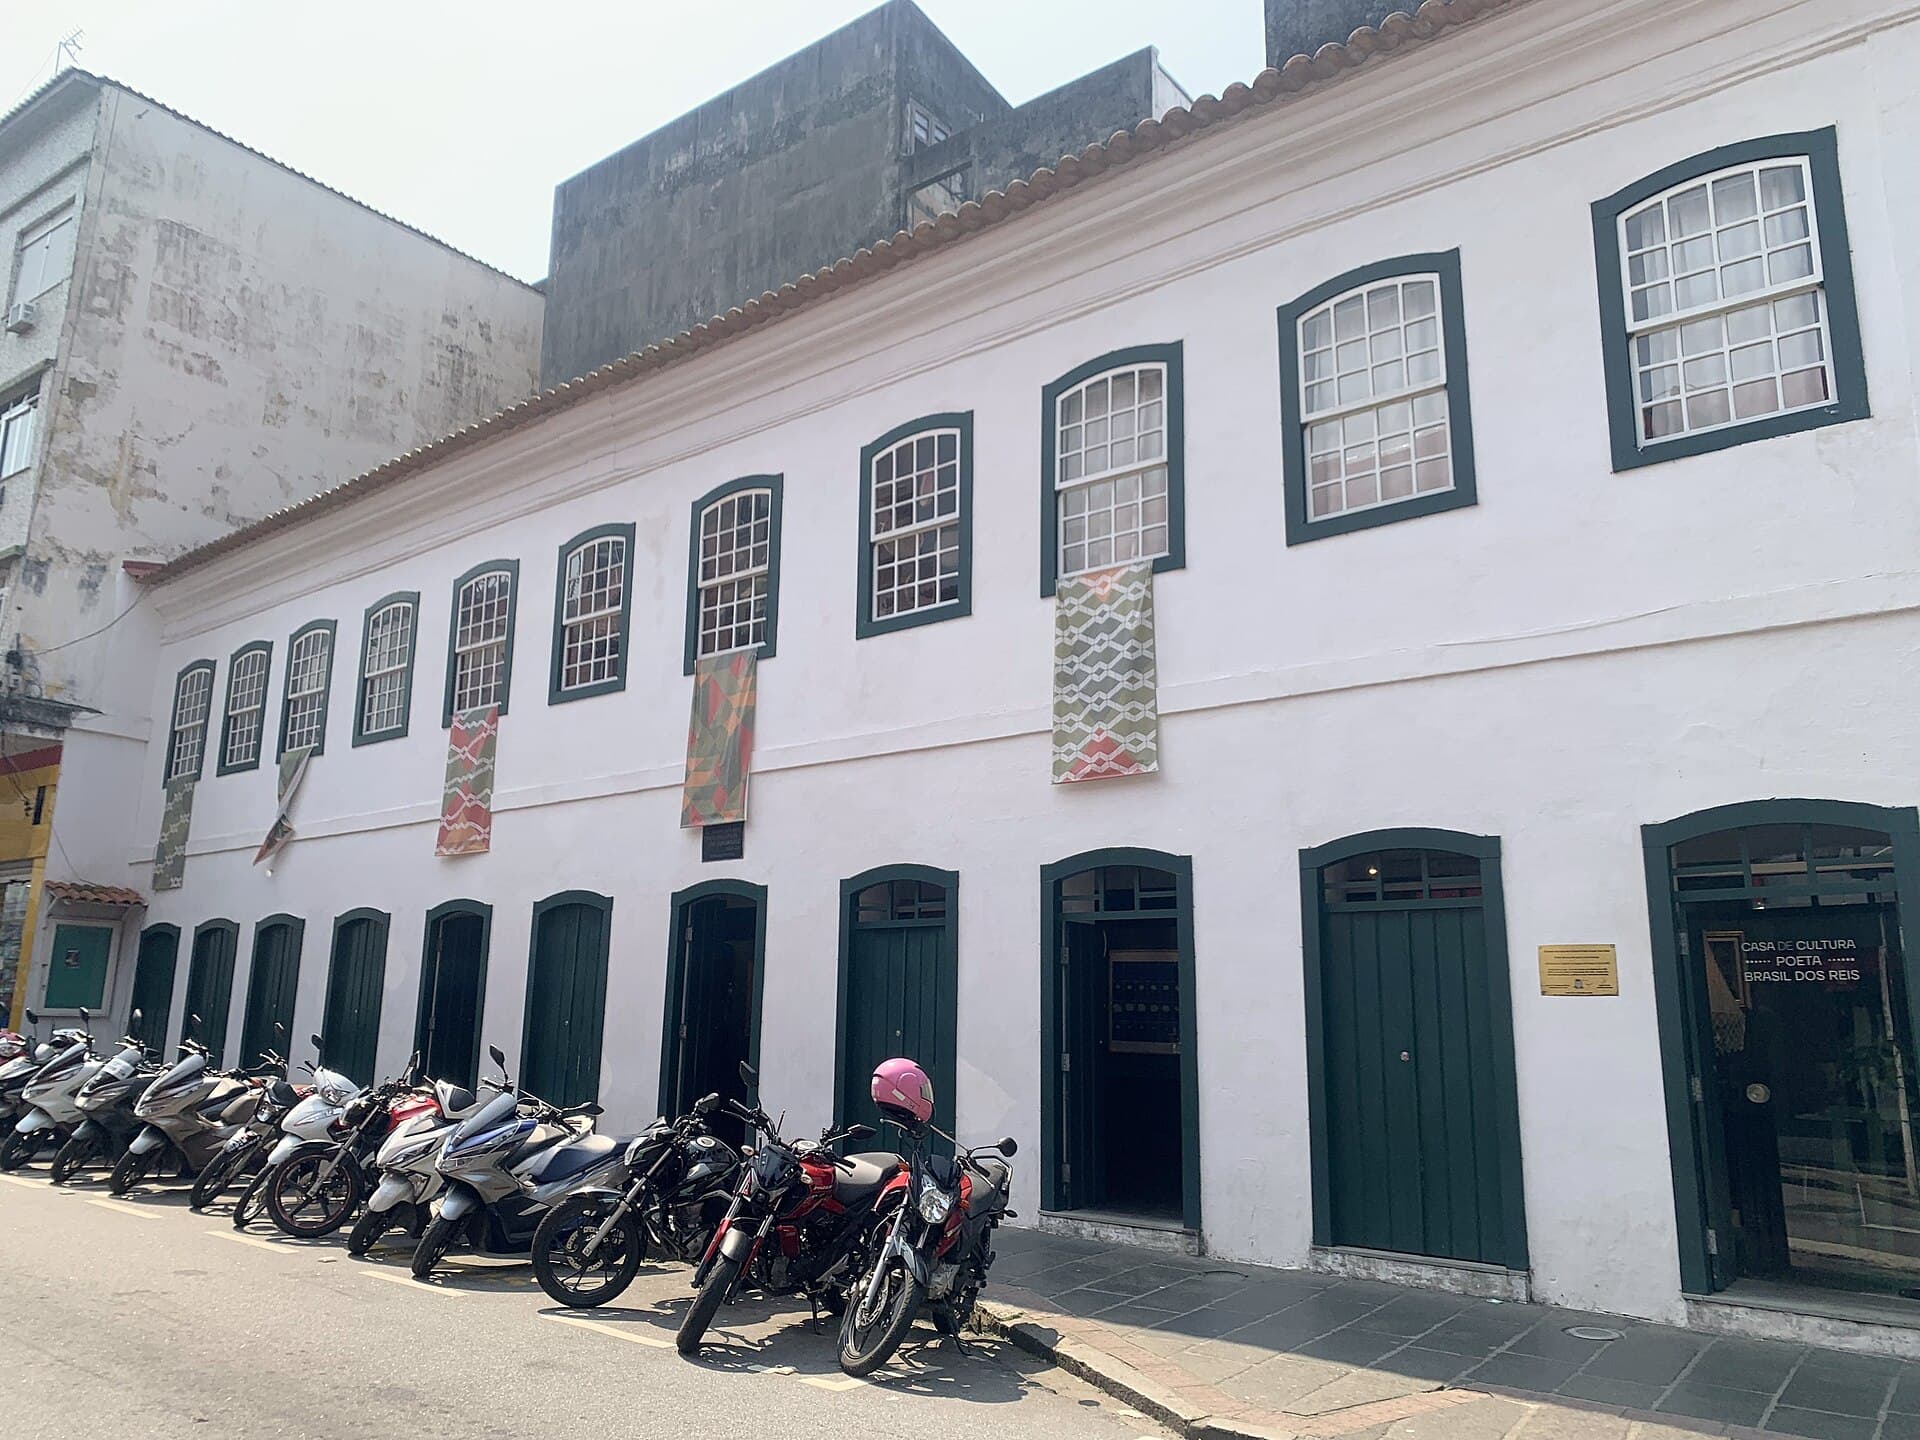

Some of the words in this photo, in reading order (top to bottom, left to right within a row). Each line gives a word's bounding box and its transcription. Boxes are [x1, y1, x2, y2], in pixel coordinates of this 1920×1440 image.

[1741, 941, 1776, 952] CASA
[1777, 940, 1793, 951] DE
[1795, 939, 1857, 951] CULTURA
[1776, 955, 1823, 967] POETA
[1743, 971, 1792, 982] BRASIL
[1794, 970, 1825, 981] DOS
[1828, 969, 1861, 981] REIS
